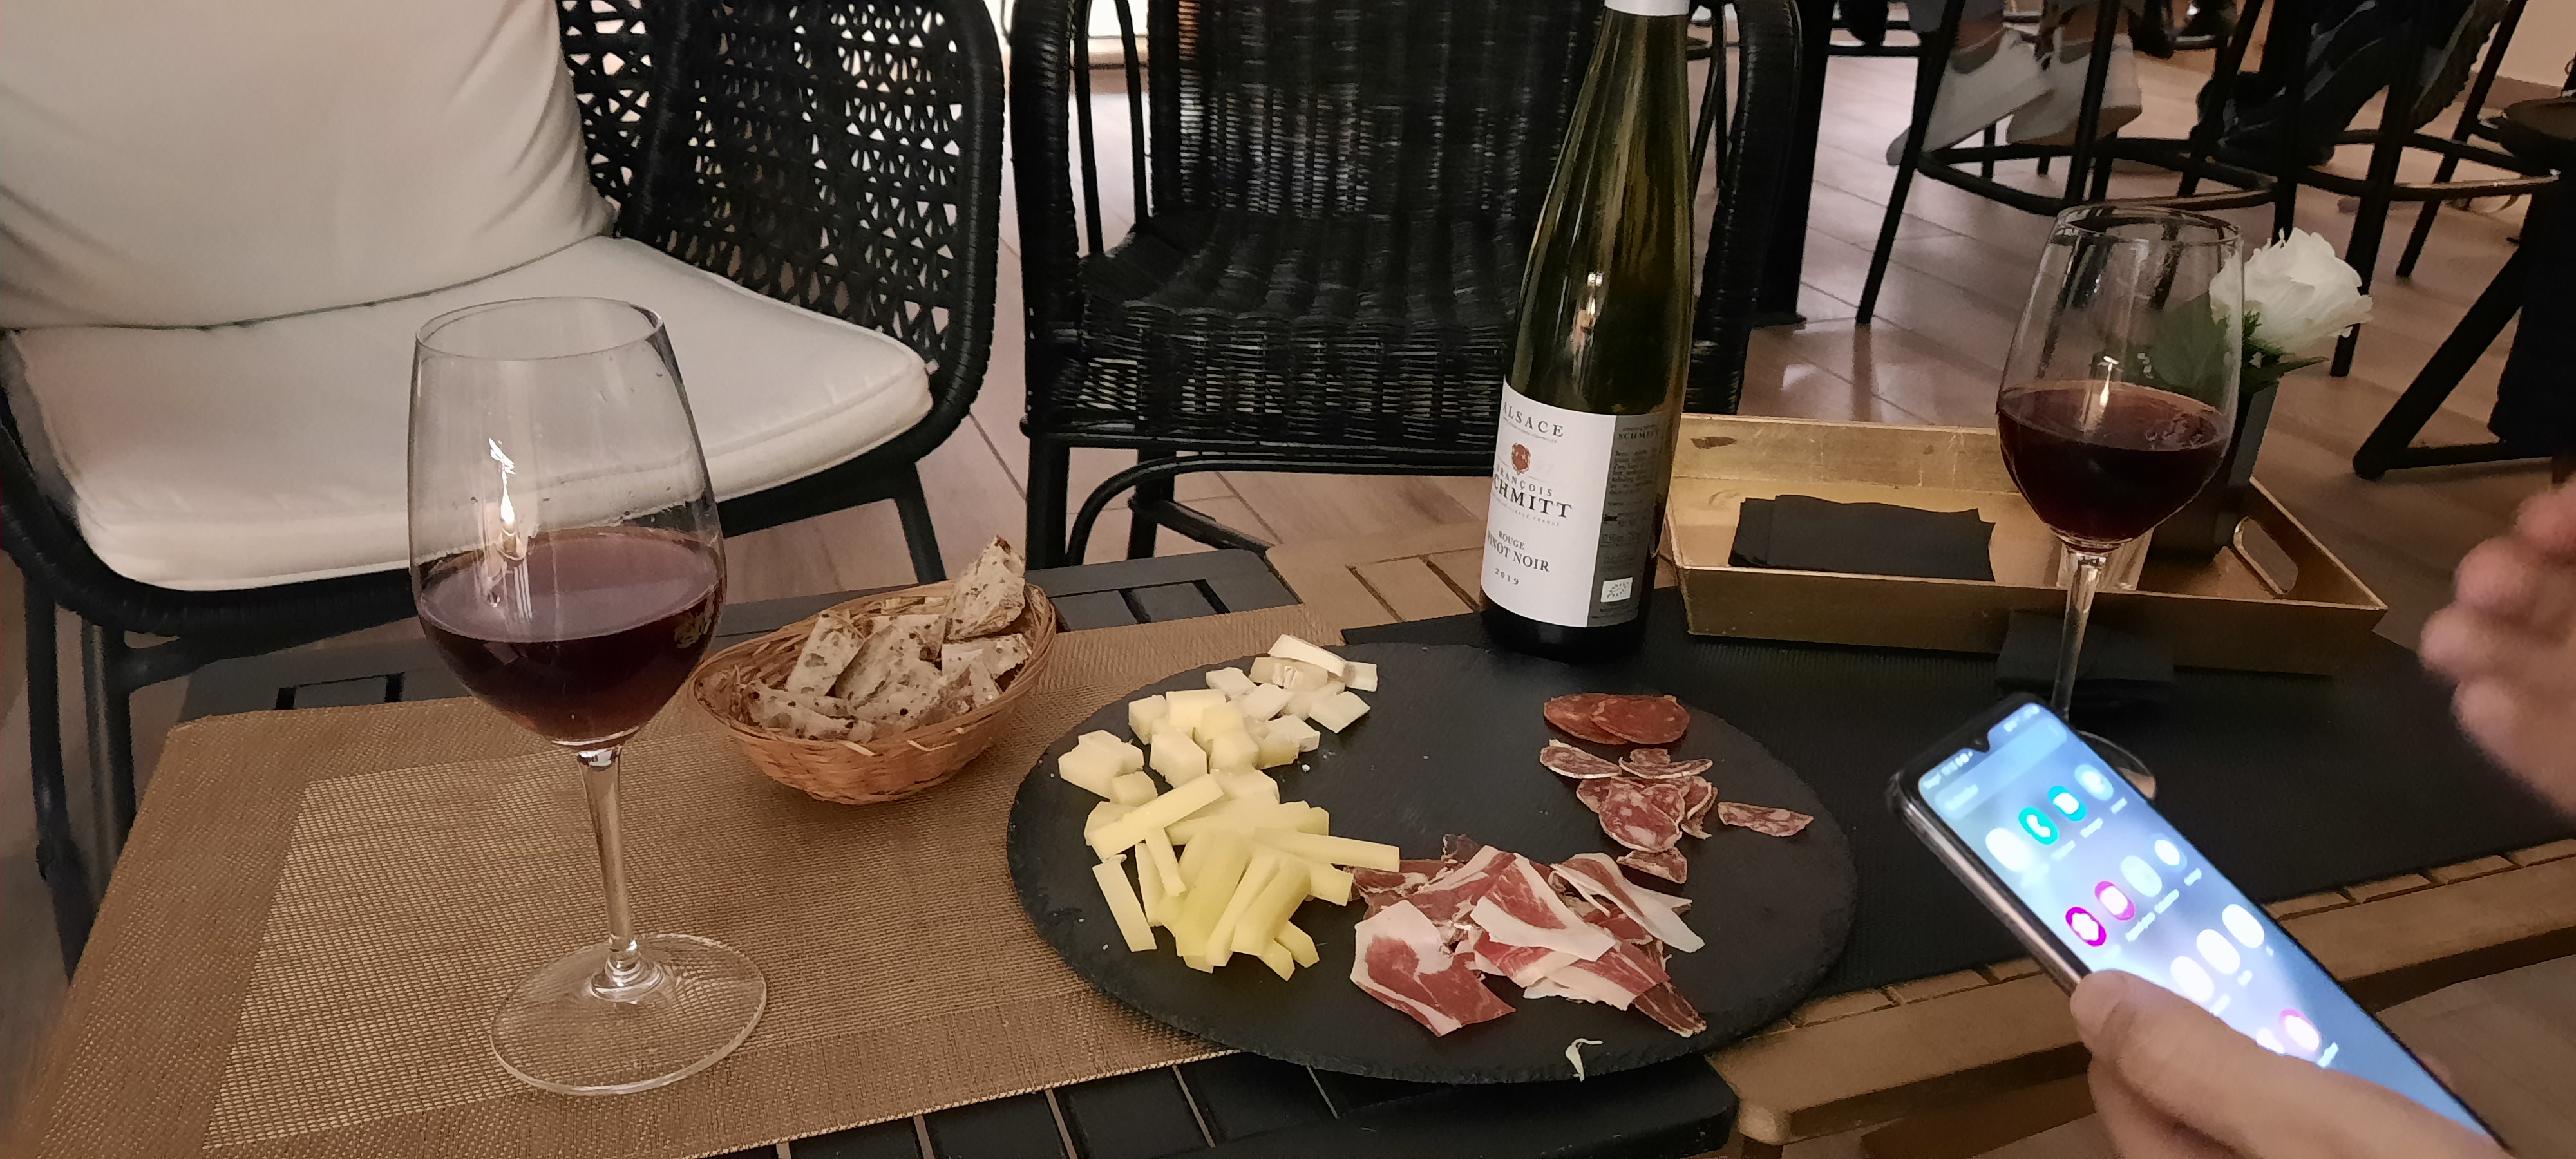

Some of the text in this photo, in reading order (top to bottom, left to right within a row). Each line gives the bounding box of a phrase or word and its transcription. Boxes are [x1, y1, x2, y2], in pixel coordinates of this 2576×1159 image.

[1503, 401, 1564, 437] ALSACE
[1493, 473, 1573, 518] CHMITT
[1496, 463, 1553, 497] FRANÇOIS
[1487, 529, 1549, 572] PINOT NOIR
[1499, 530, 1525, 551] ROUGE
[1495, 567, 1519, 585] 2019
